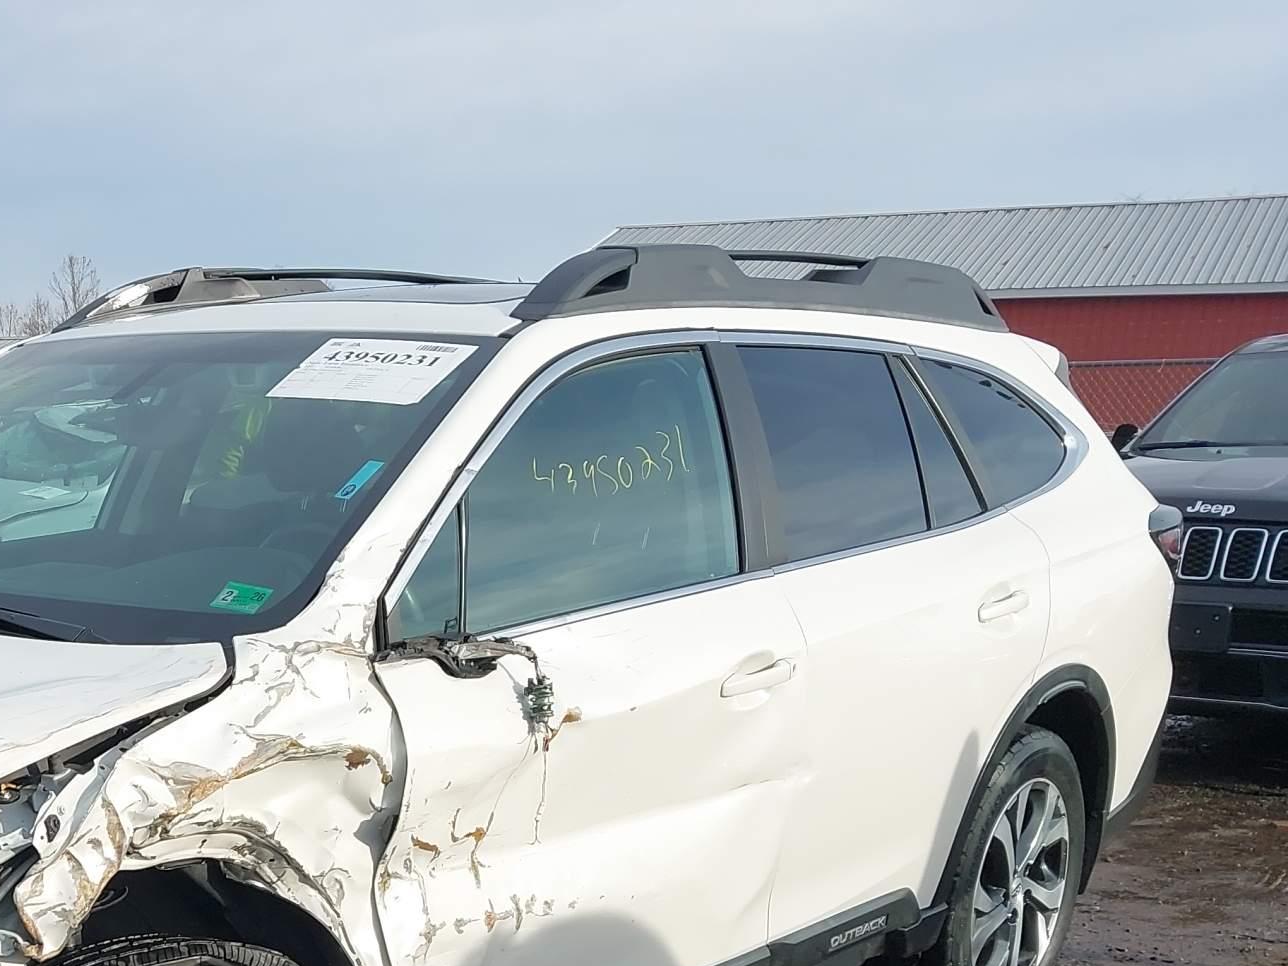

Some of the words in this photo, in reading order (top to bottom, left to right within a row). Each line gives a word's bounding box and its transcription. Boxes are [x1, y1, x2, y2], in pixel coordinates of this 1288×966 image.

[324, 350, 442, 368] 43950231
[532, 424, 691, 497] 43950231
[1186, 500, 1236, 517] Jeep
[221, 590, 234, 602] 2
[830, 915, 888, 948] OUTBACK
